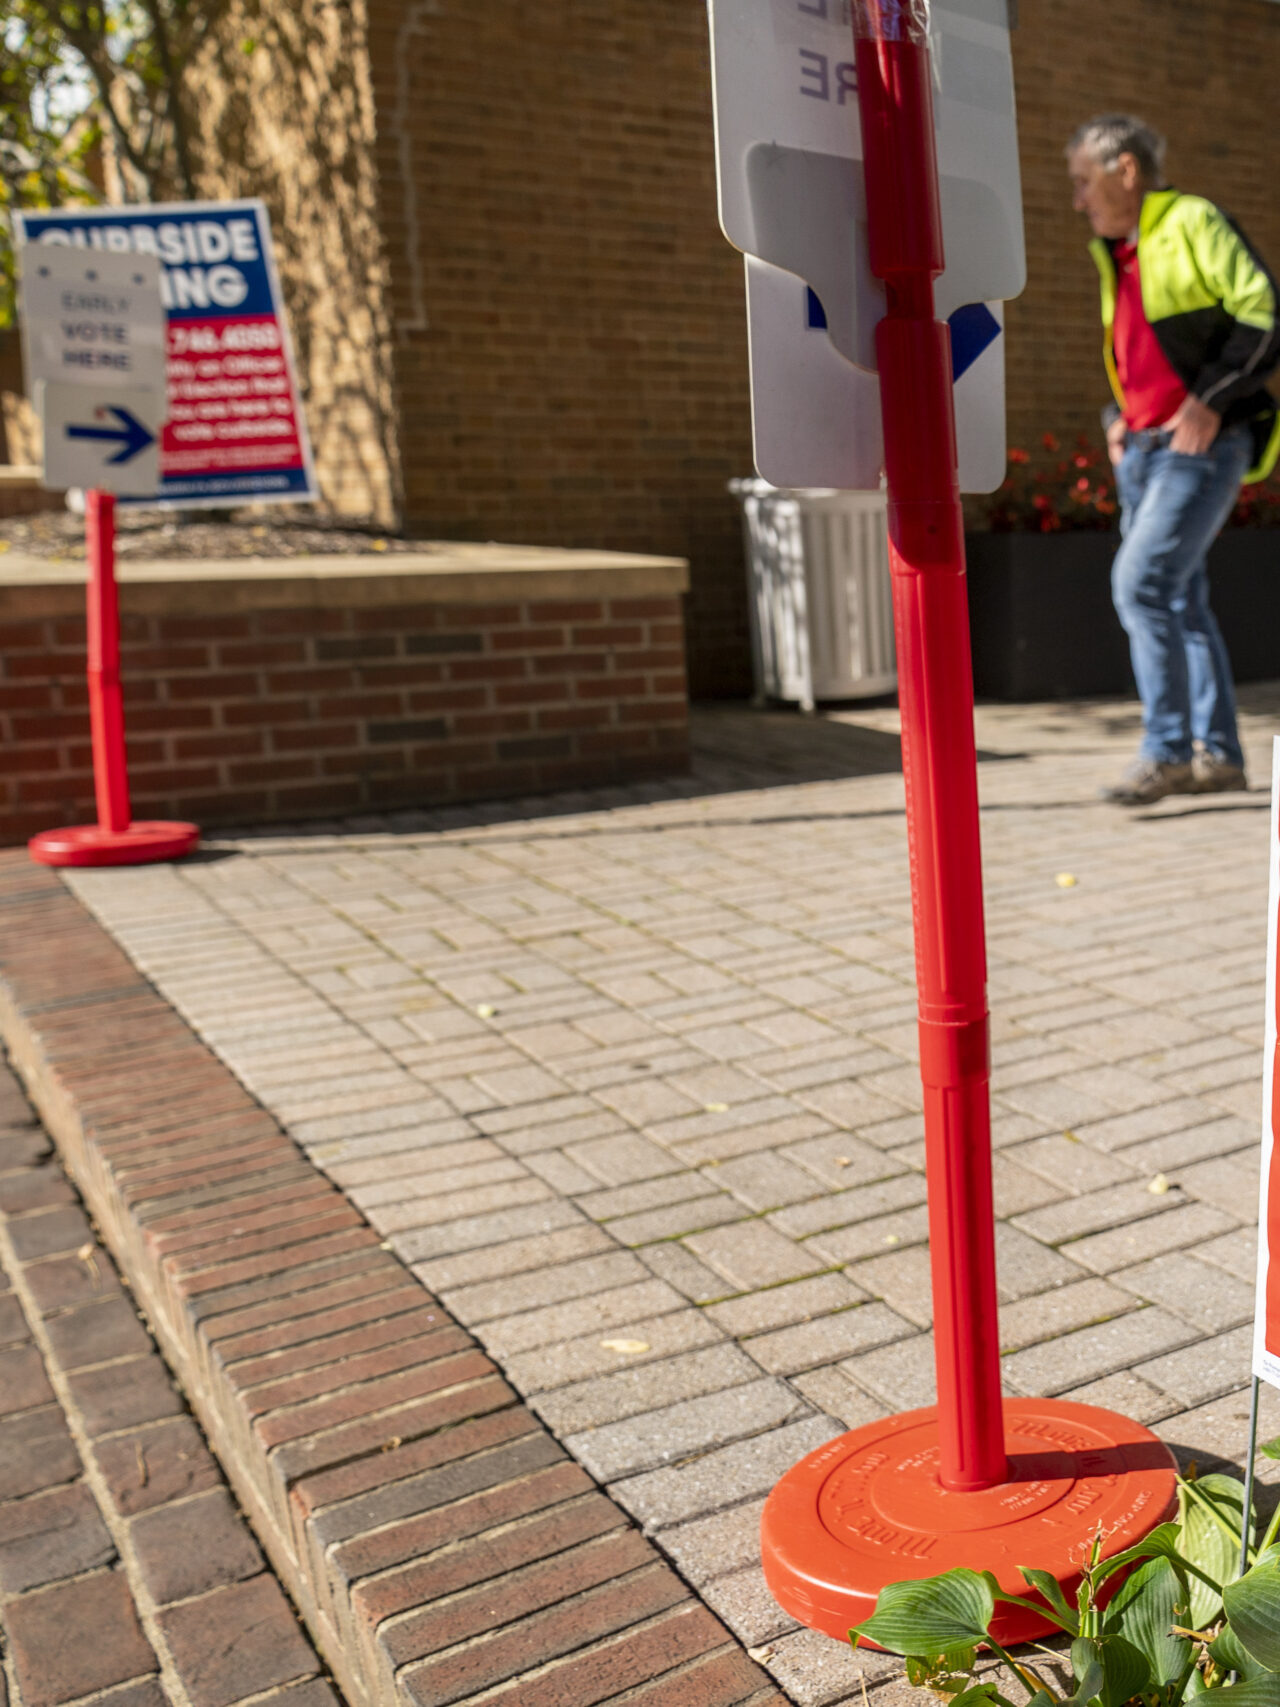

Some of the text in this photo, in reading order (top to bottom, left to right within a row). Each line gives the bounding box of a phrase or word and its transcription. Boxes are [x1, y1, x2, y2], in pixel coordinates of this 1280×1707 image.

[61, 292, 131, 315] EARLY
[61, 320, 131, 346] VOTE
[63, 348, 132, 372] HERE
